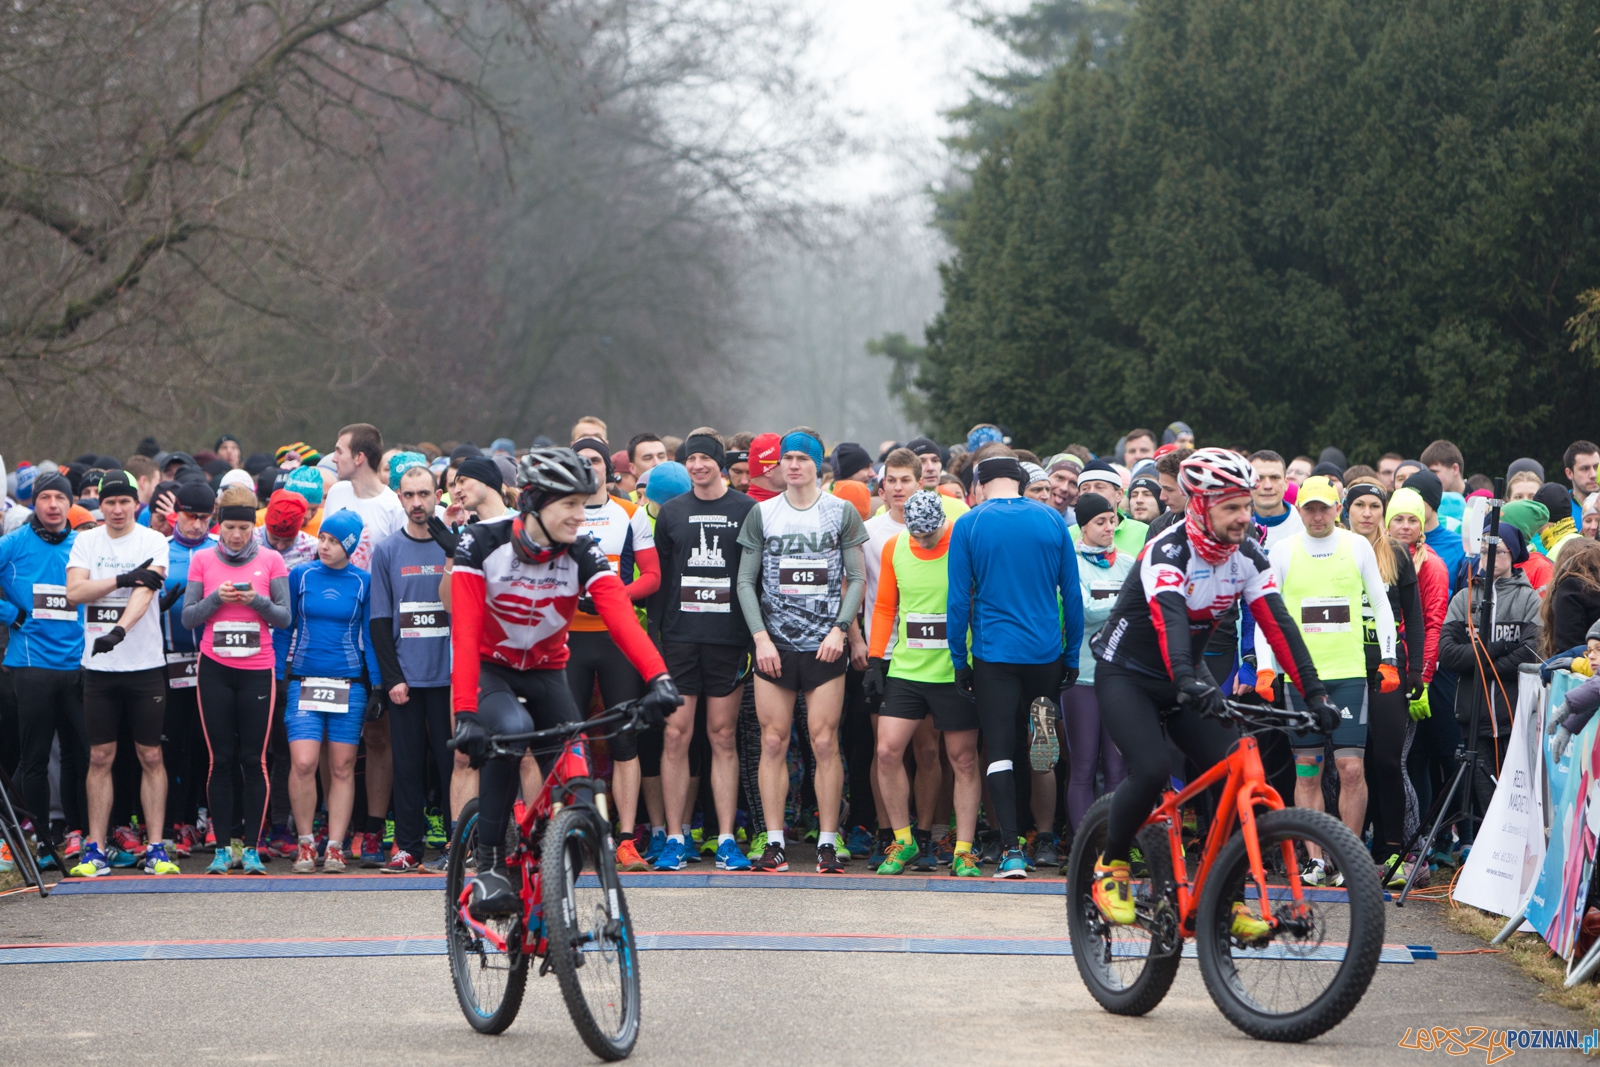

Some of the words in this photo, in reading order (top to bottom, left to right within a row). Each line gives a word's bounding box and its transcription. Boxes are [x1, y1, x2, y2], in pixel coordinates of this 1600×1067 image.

[792, 571, 815, 582] 615
[694, 589, 717, 600] 164
[46, 596, 67, 608] 390
[97, 609, 119, 621] 540
[413, 614, 436, 626] 306
[1322, 609, 1330, 620] 1
[920, 626, 935, 637] 11
[225, 633, 248, 645] 511
[312, 689, 336, 700] 273
